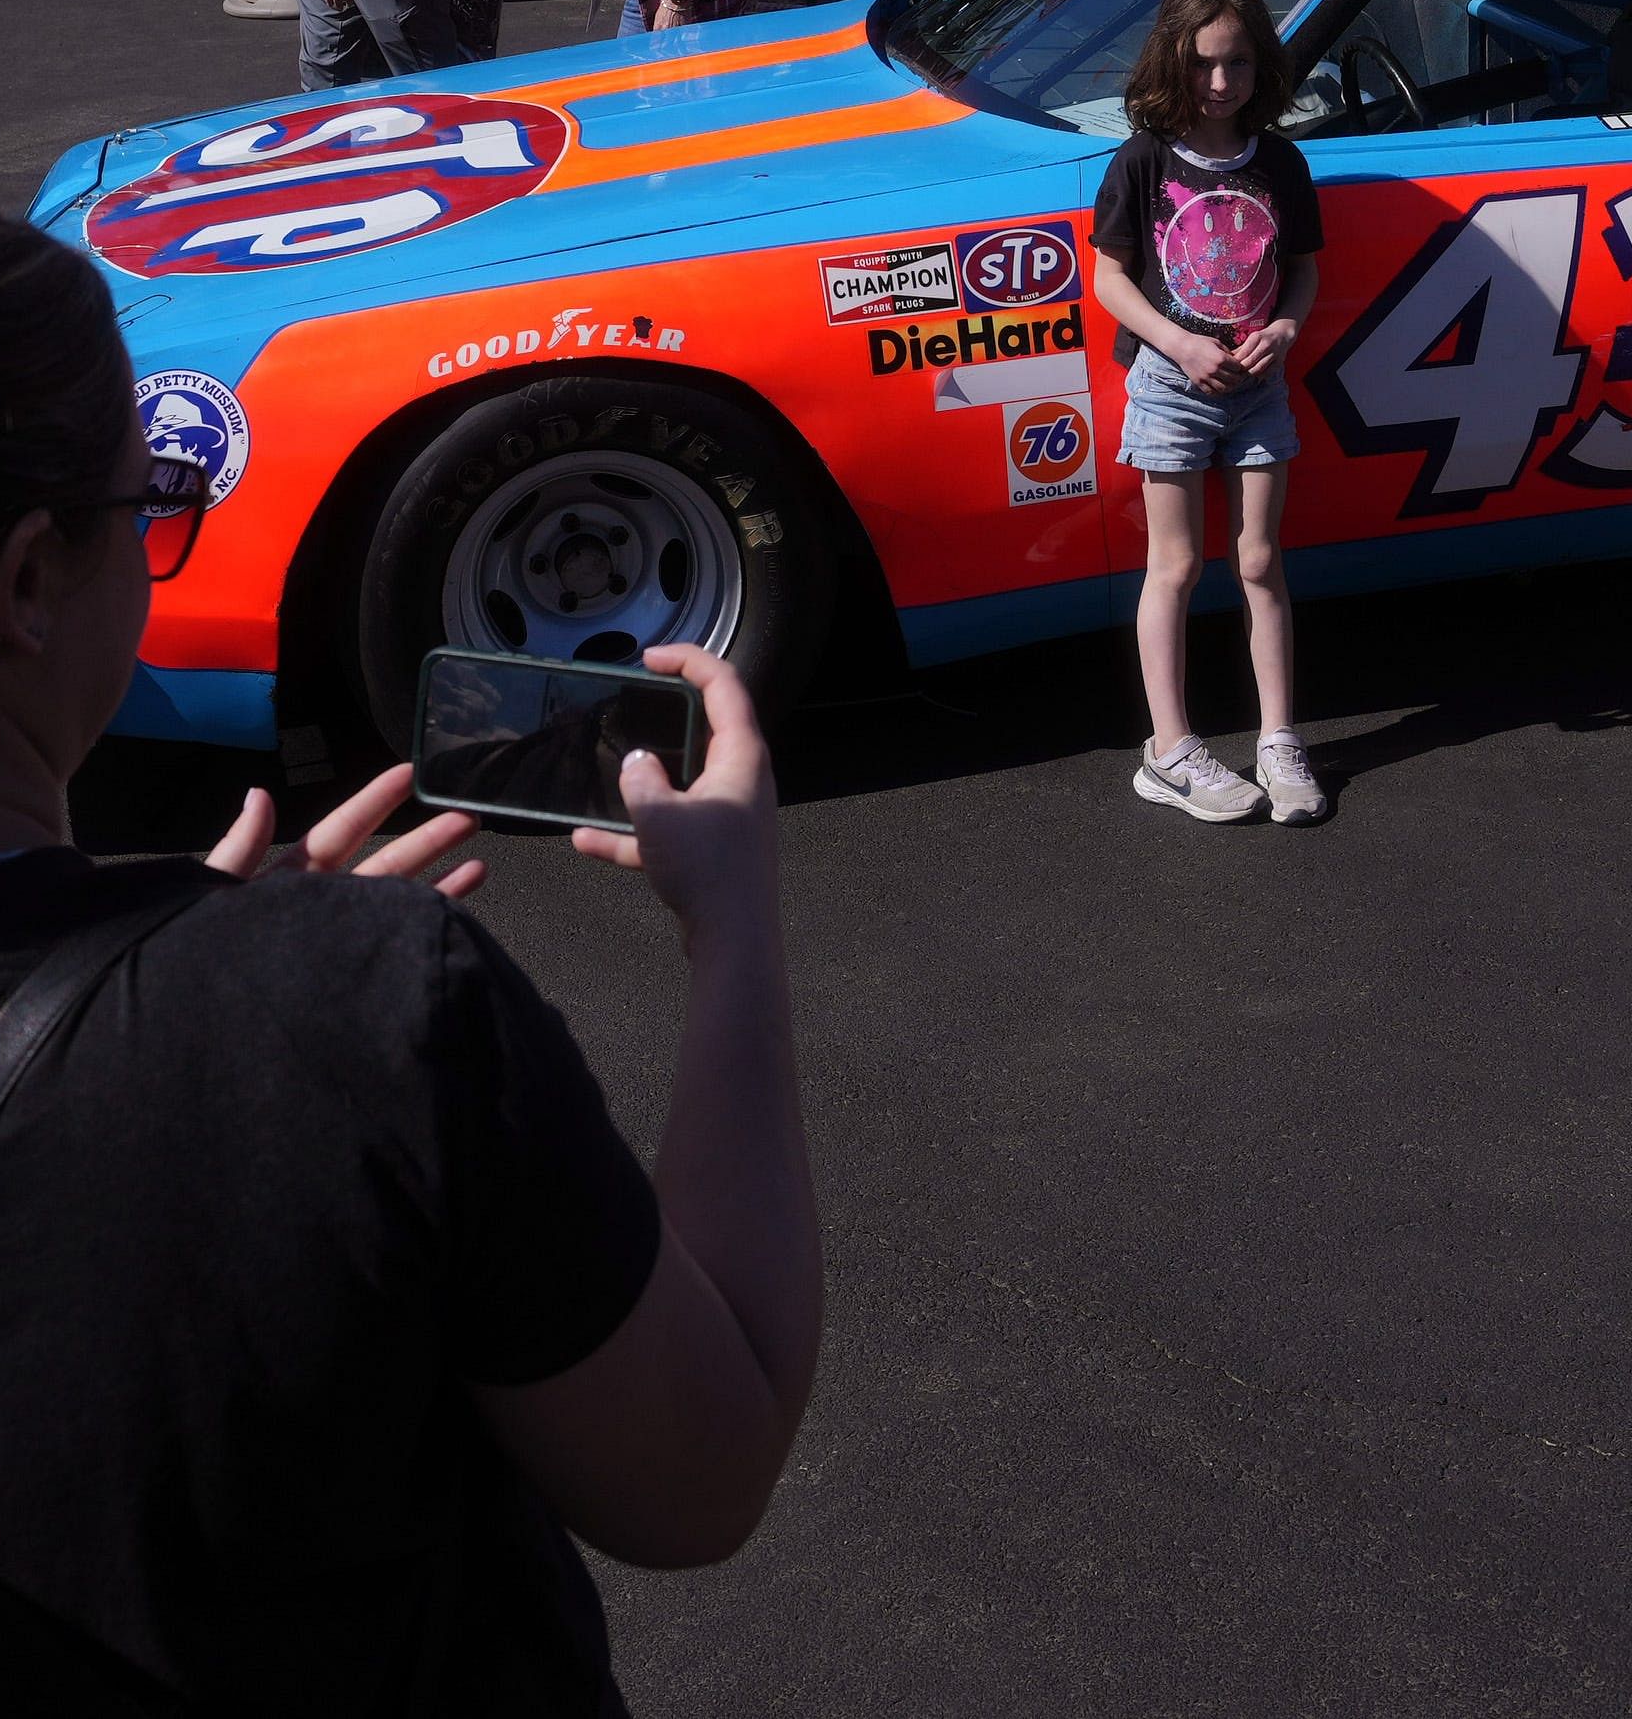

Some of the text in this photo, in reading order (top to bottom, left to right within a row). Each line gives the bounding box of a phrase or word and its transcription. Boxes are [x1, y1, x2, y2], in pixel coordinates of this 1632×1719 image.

[136, 106, 536, 256] STP
[853, 250, 923, 268] EQUIPPED WITH
[979, 235, 1058, 290] STP
[832, 266, 949, 300] CHAMPION
[1006, 291, 1041, 302] OIL FILTER
[862, 298, 925, 315] SPARK PLUGS
[868, 304, 1085, 377] DieHard
[153, 374, 245, 436] PETTY MUSEUM
[1019, 413, 1081, 469] 76
[215, 467, 240, 494] N.C.
[1013, 480, 1094, 504] GASOLINE
